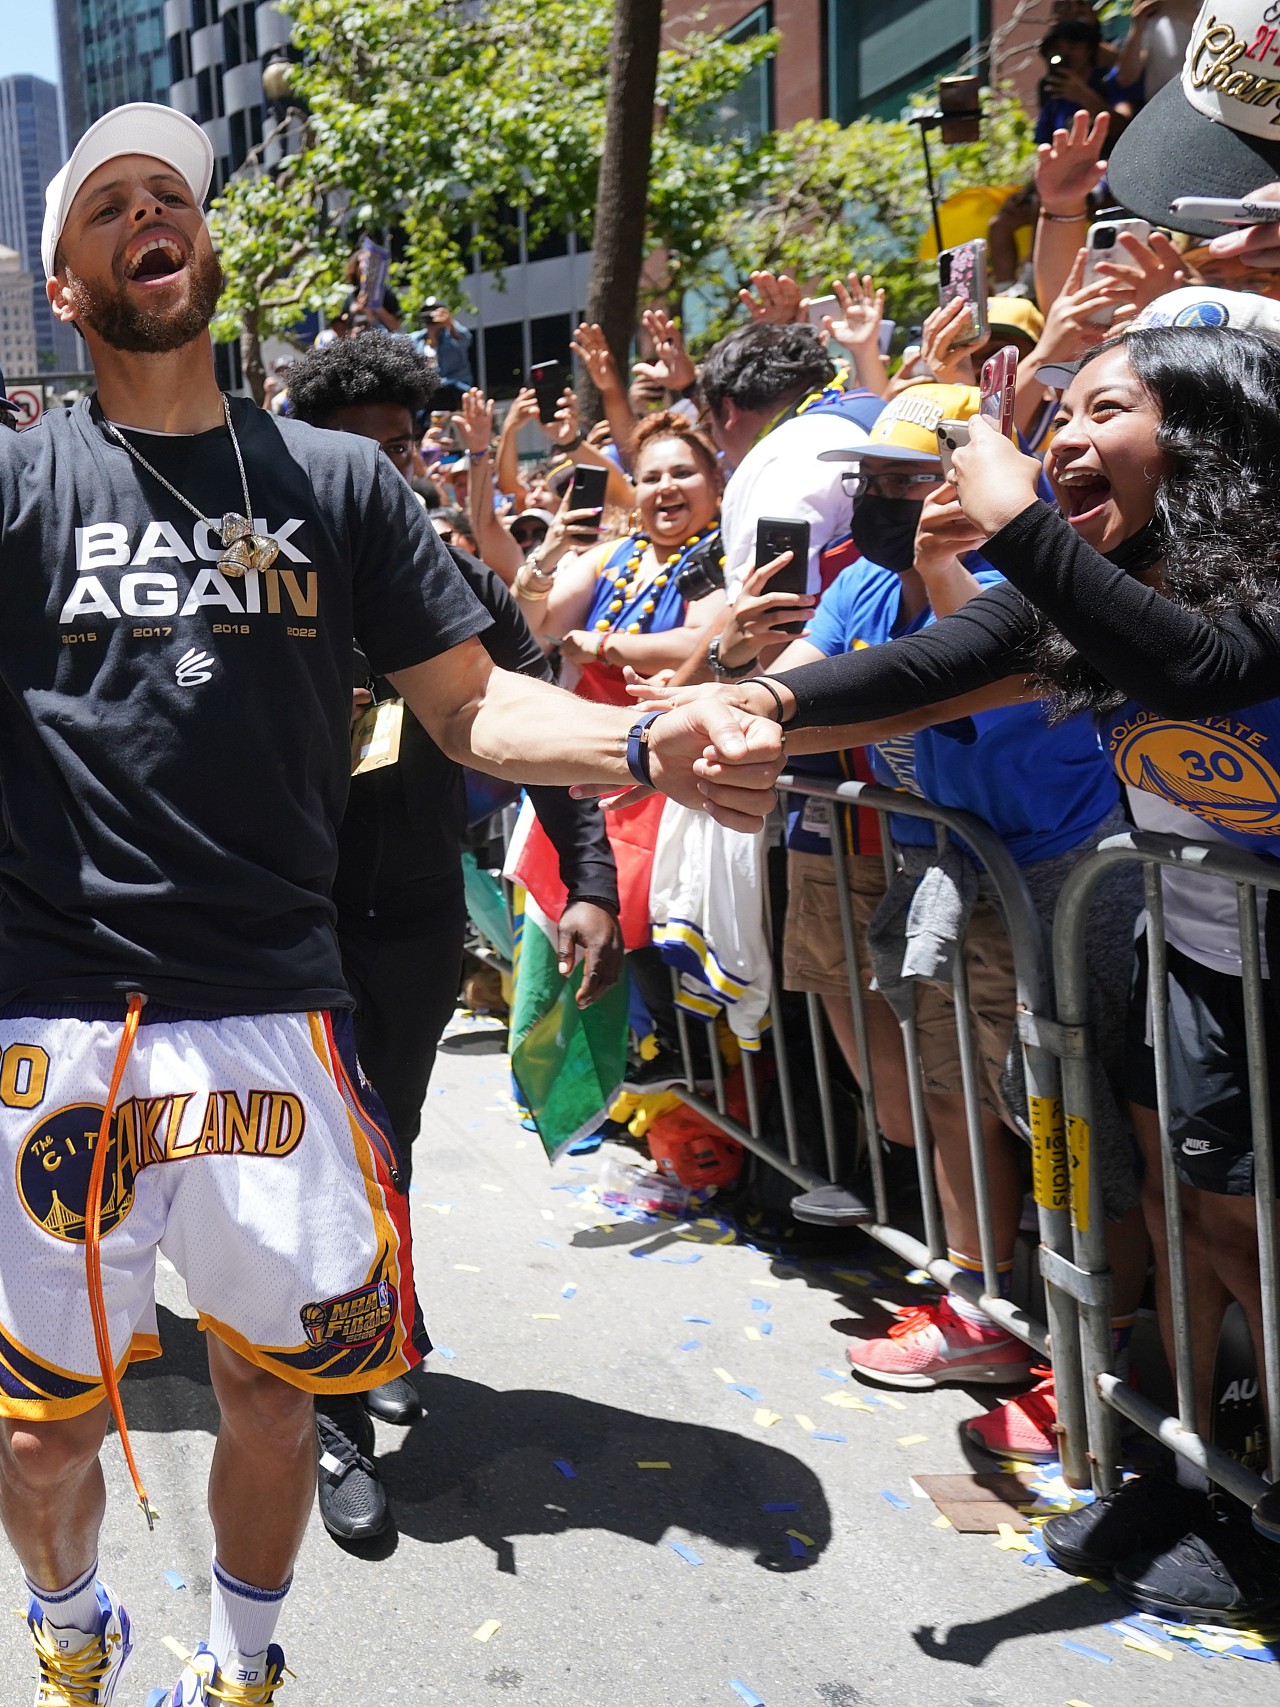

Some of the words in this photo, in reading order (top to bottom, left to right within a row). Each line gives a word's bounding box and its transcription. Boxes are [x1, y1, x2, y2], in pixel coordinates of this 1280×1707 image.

[59, 569, 318, 623] AGAIN
[133, 627, 172, 637] 2017
[212, 624, 249, 634] 2018
[287, 627, 316, 637] 2022
[1178, 750, 1243, 782] 30
[1031, 1100, 1041, 1126] 415
[30, 1135, 54, 1157] The
[1185, 1138, 1211, 1151] NIKE
[1052, 1127, 1069, 1207] rentals
[331, 1291, 377, 1320] NBA
[325, 1305, 390, 1338] Finals
[236, 1669, 259, 1681] 30
